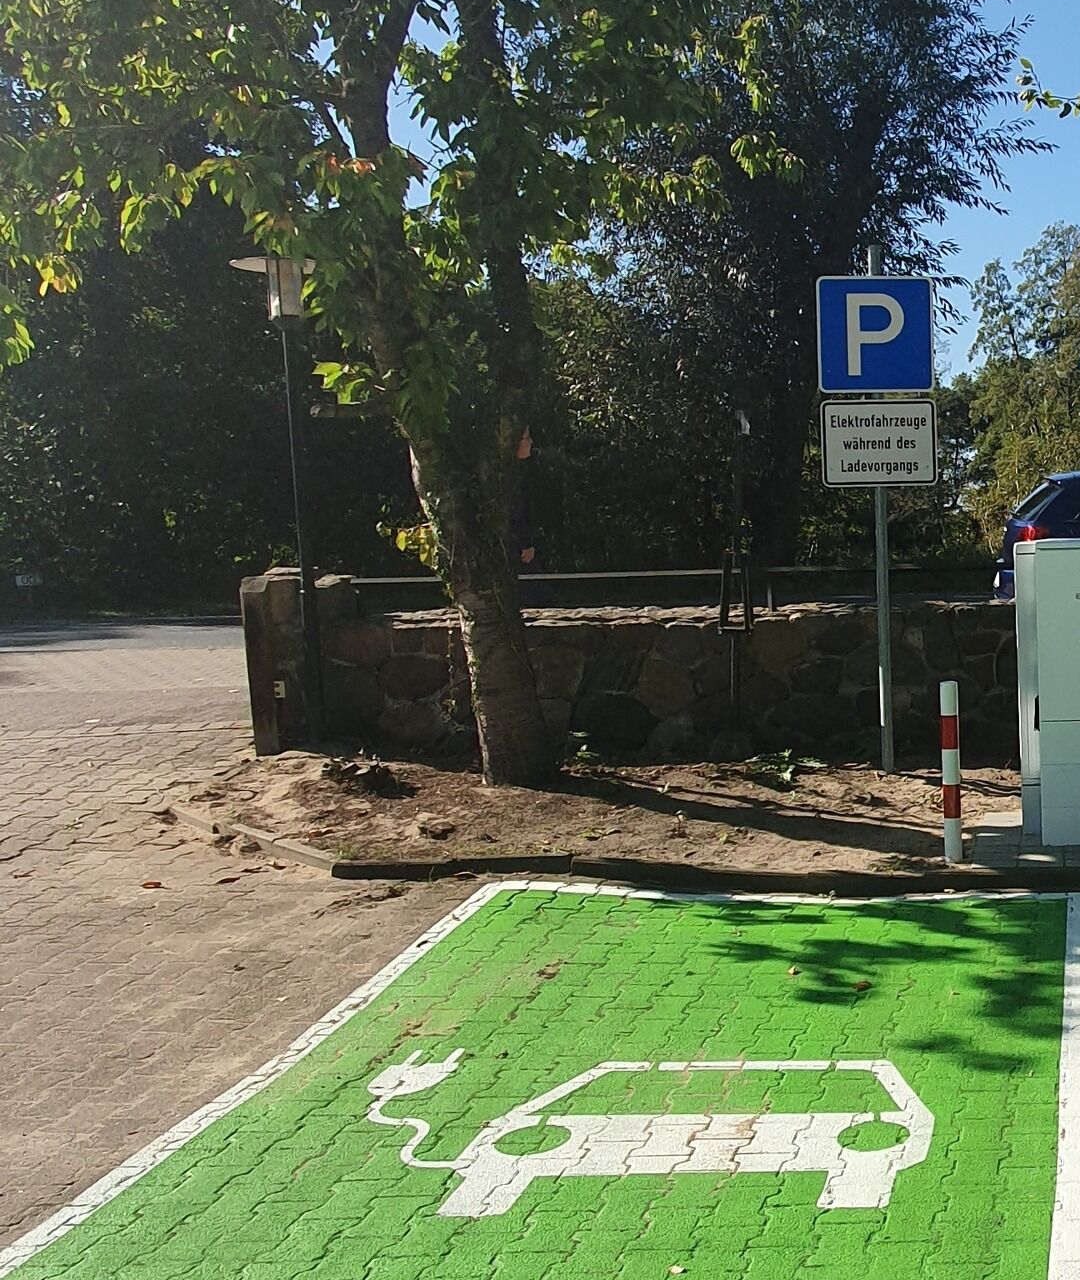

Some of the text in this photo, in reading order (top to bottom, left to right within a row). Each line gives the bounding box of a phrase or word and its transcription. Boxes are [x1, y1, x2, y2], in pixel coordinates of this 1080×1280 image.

[846, 293, 904, 376] P
[830, 415, 927, 430] Elektrofahrzeuge
[843, 436, 916, 450] während des
[840, 459, 919, 475] Ladevorgangs
